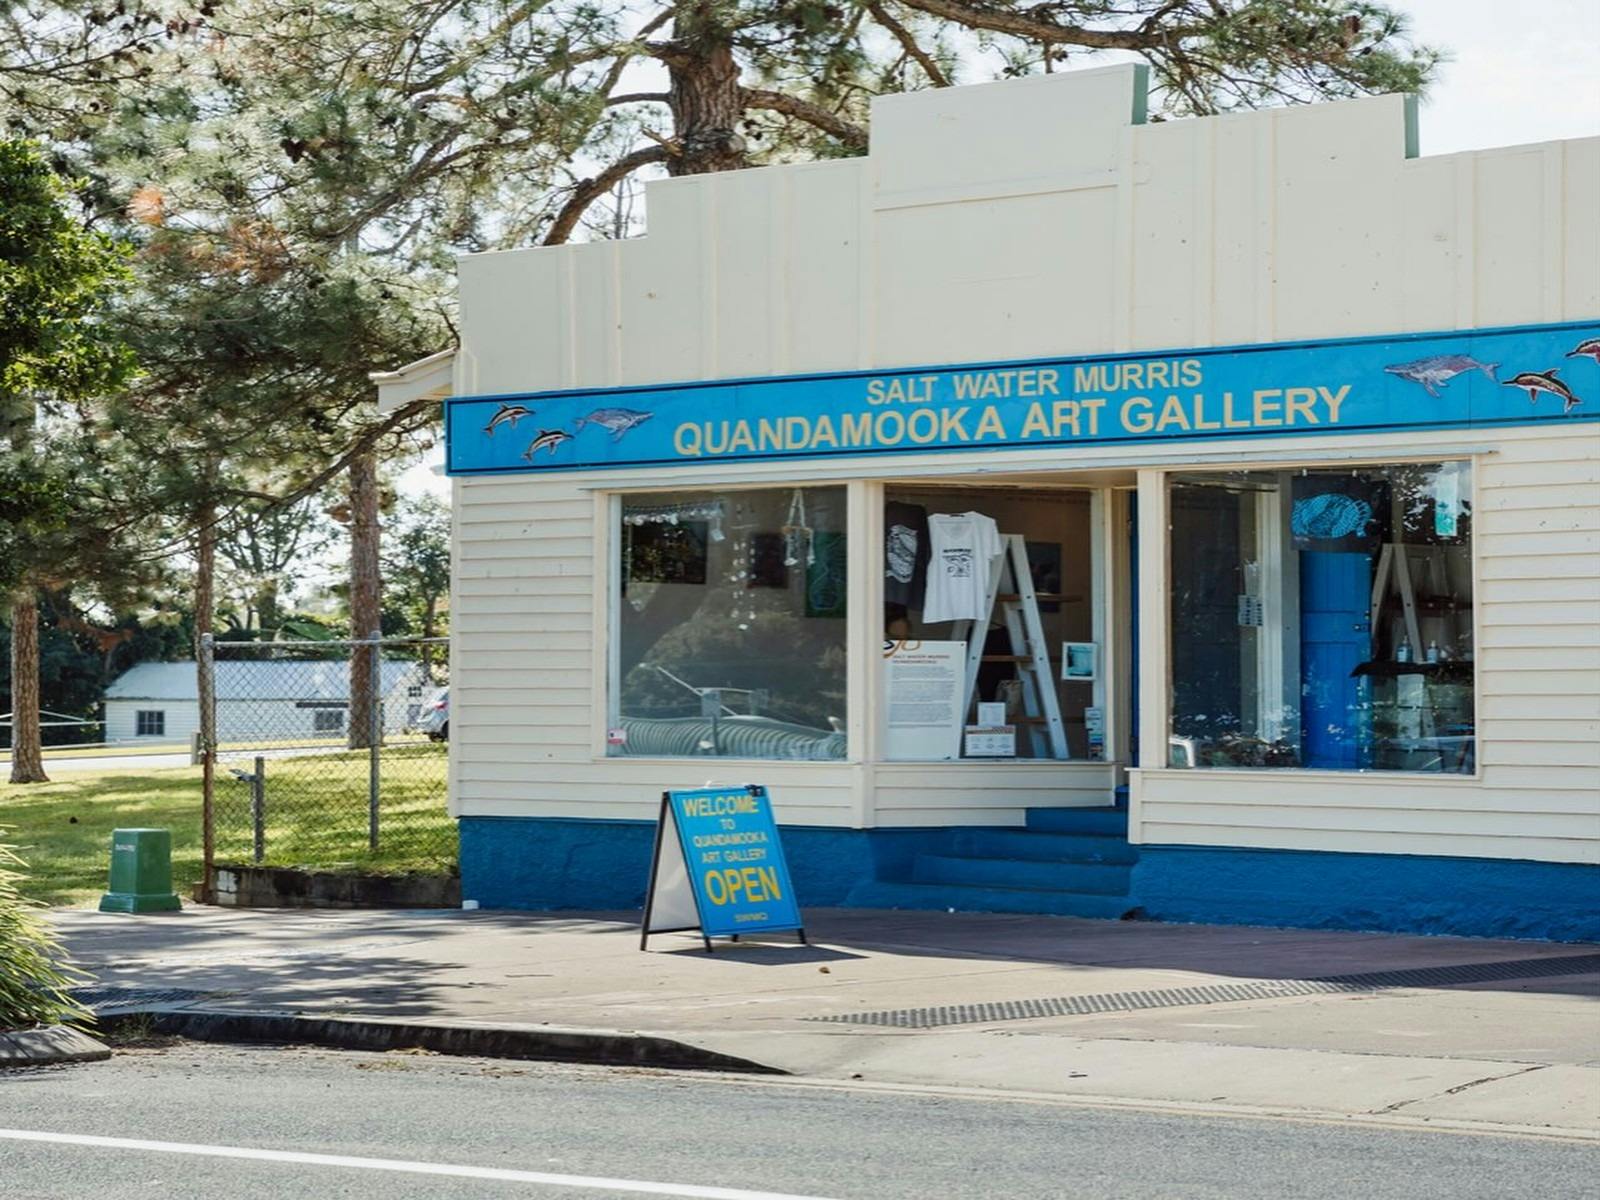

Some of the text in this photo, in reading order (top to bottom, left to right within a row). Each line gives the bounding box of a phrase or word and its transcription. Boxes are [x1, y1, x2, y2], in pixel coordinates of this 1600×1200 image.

[866, 359, 1203, 405] SALT WATER MURRIS
[673, 385, 1352, 457] QUANDAMOOKA ART GALLERY
[683, 796, 759, 816] WELCOME
[720, 819, 735, 830] TO
[703, 849, 766, 863] ART GALLERY
[705, 866, 781, 905] OPEN
